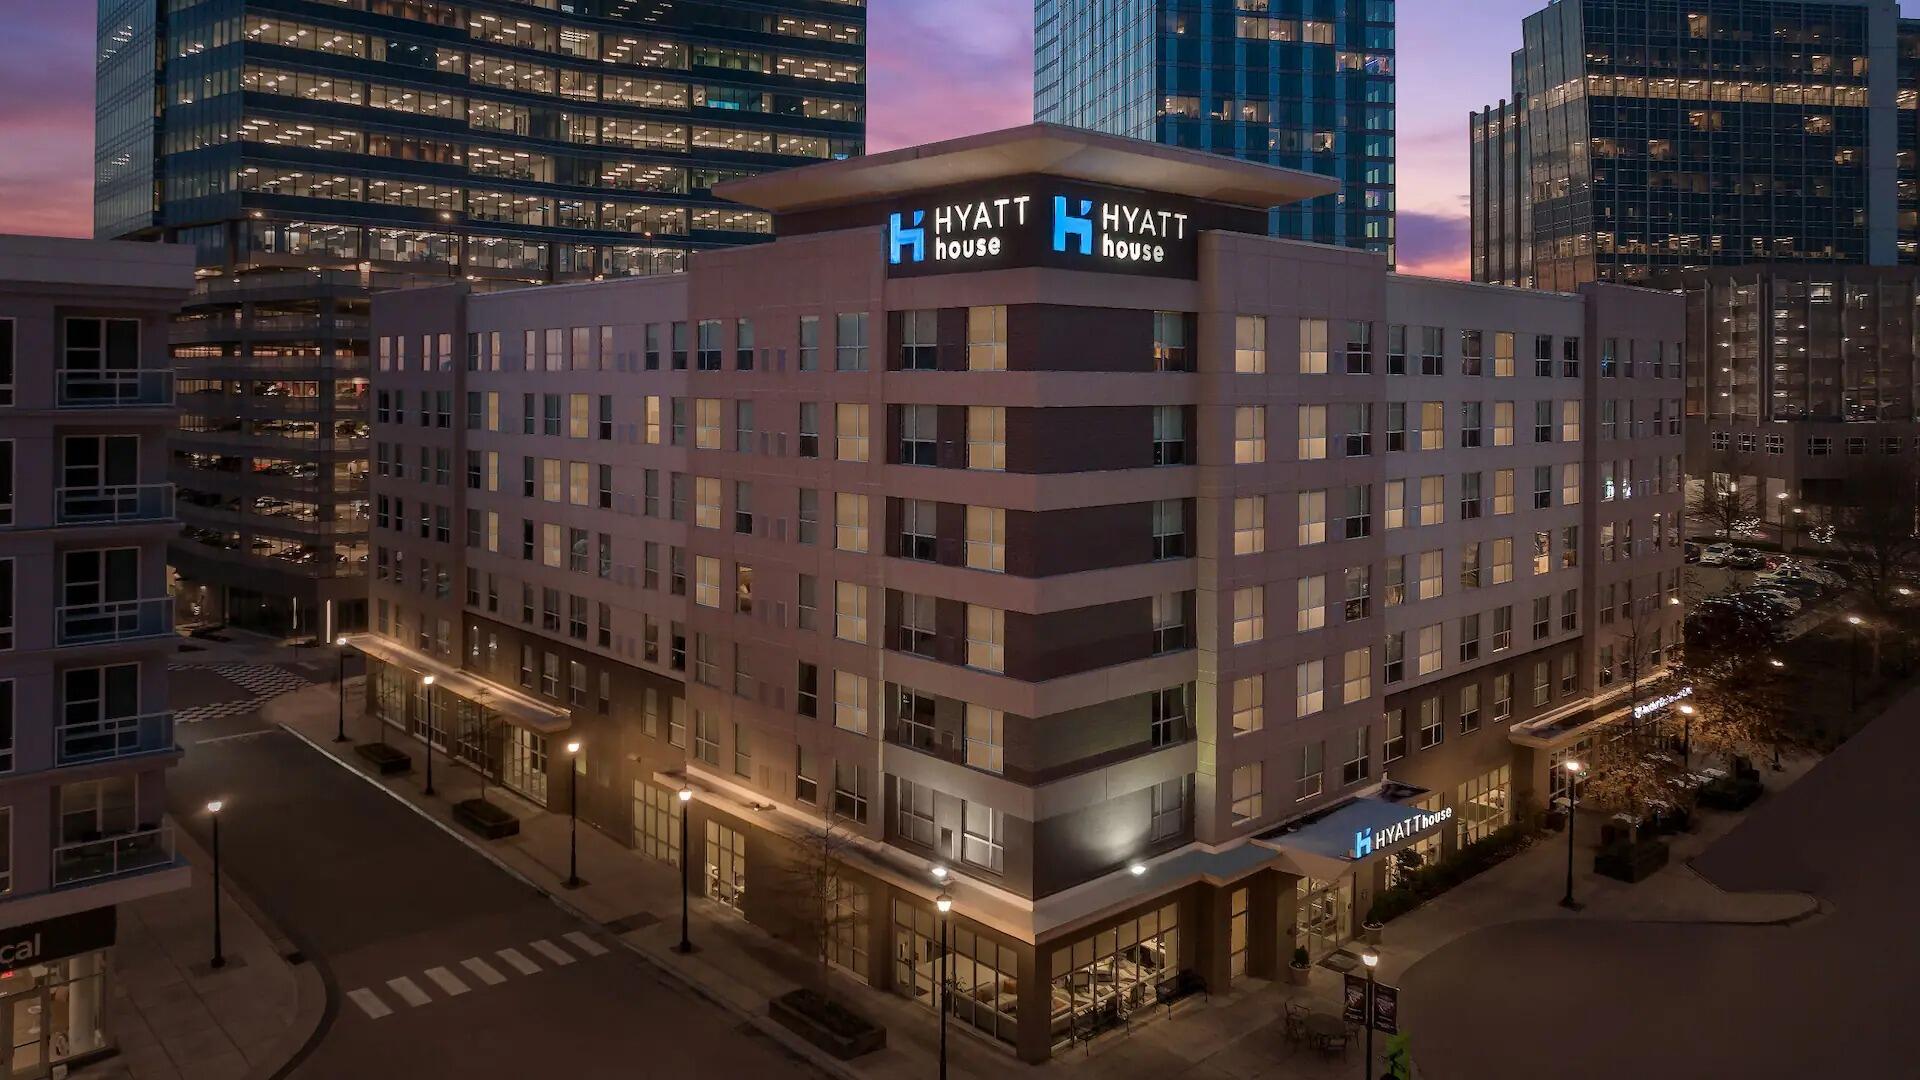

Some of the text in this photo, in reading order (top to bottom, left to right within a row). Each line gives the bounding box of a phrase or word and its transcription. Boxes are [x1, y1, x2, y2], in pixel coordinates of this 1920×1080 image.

[935, 195, 1030, 235] HYATT
[1102, 202, 1188, 239] HYATT
[935, 235, 1001, 260] house
[1102, 233, 1165, 263] house
